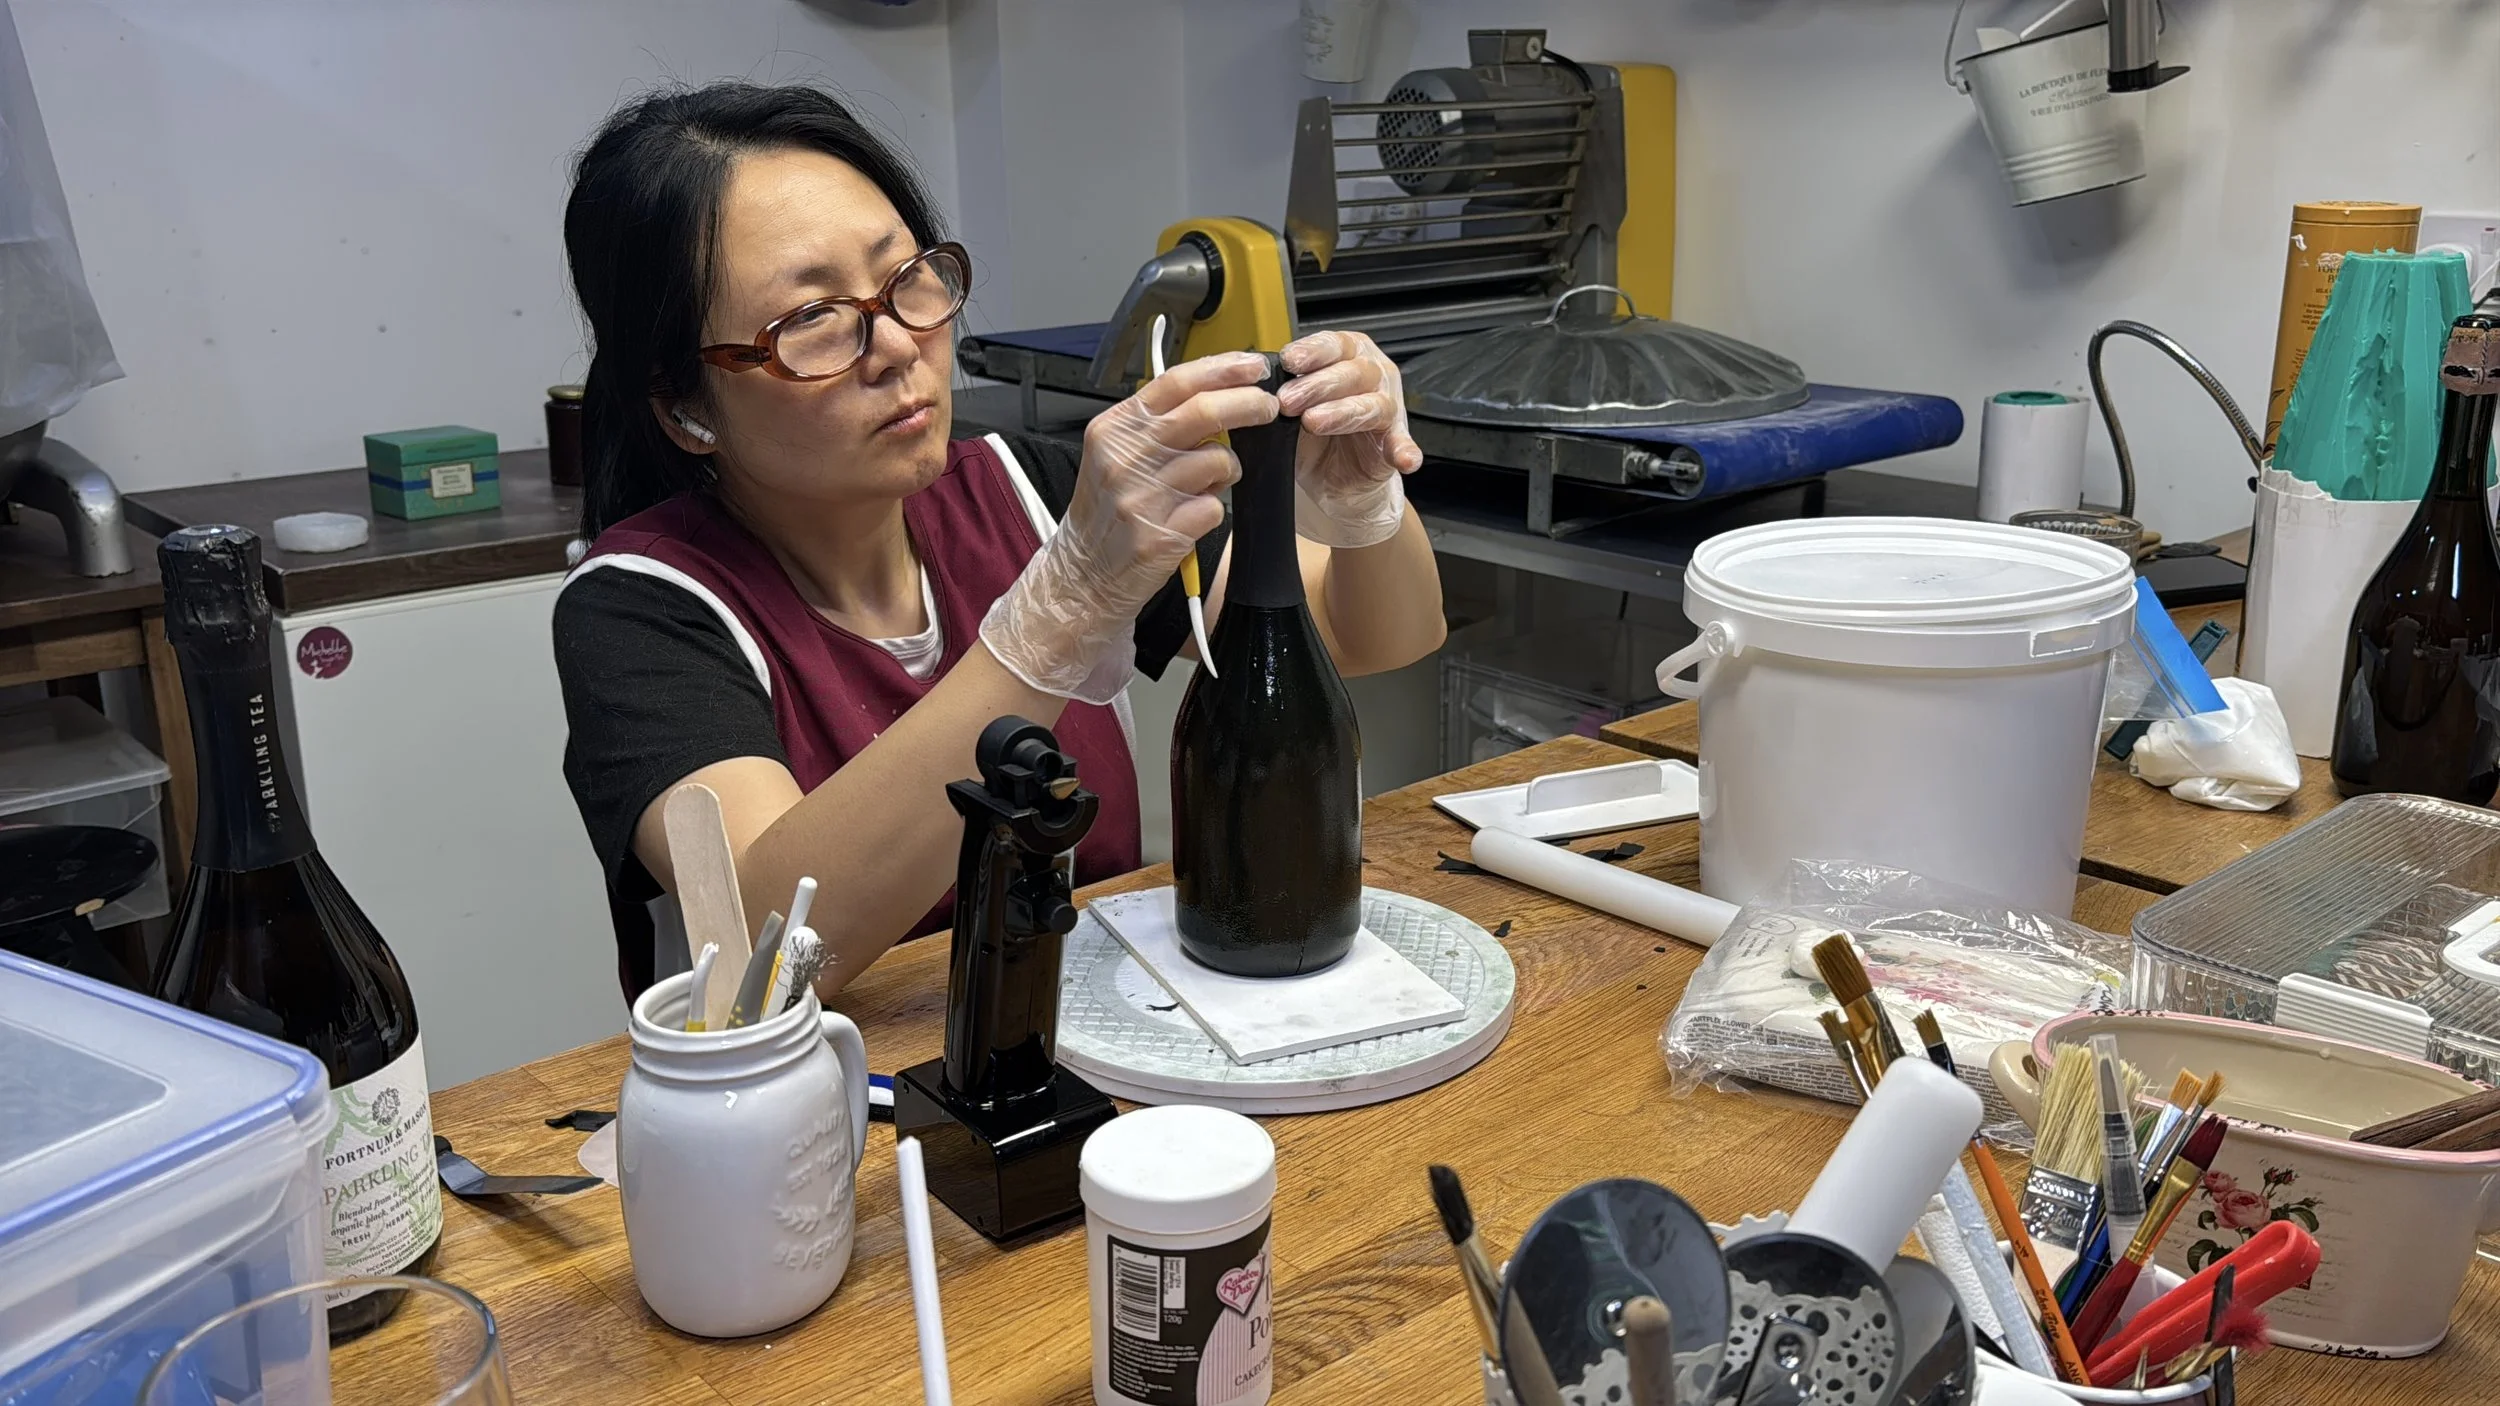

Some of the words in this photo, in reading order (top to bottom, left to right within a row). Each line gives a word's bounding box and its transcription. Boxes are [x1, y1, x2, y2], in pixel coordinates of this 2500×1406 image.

[2019, 89, 2031, 98] LA
[2031, 73, 2076, 94] BOUTIQUE
[249, 693, 265, 727] TEA
[323, 1131, 394, 1170] FORTNUM
[395, 1127, 403, 1139] &
[323, 1144, 419, 1206] PARKLING
[338, 1202, 373, 1222] Blended
[374, 1194, 392, 1211] from
[330, 1218, 364, 1237] organic
[365, 1208, 389, 1229] black,
[341, 1231, 371, 1248] FRESH
[385, 1207, 413, 1229] HERBAL
[369, 1235, 397, 1252] PRODUCED
[366, 1255, 398, 1274] PICCADILLY
[1222, 1269, 1260, 1294] Rainbow
[1230, 1280, 1255, 1301] Dust
[1163, 1314, 1183, 1325] 120g
